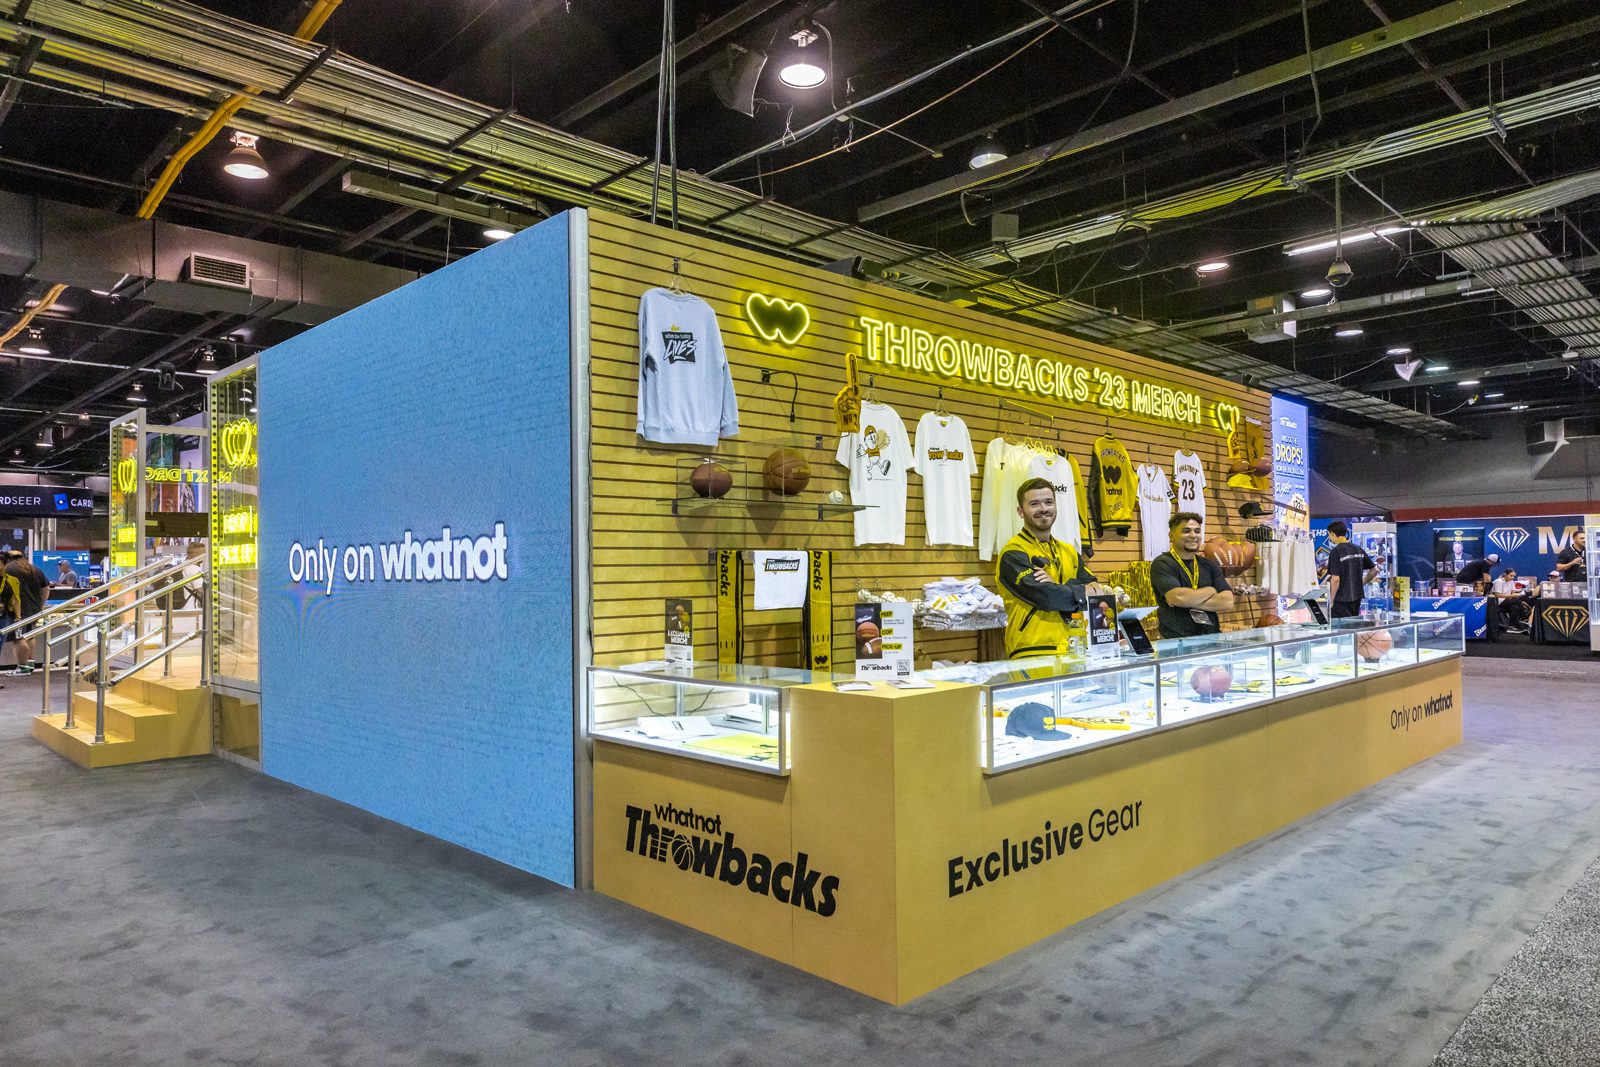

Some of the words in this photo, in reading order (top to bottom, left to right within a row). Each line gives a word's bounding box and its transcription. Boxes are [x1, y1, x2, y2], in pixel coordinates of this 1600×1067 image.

[663, 339, 697, 361] LIVES
[860, 316, 1089, 401] THROWBACKS
[1094, 367, 1125, 409] '23
[1131, 380, 1201, 423] MERCH
[1275, 442, 1304, 466] DROPS!
[1182, 479, 1195, 500] 23
[289, 538, 337, 595] Only
[343, 544, 375, 581] on
[380, 521, 507, 582] whatnot
[1391, 705, 1410, 731] Only
[1412, 705, 1422, 722] on
[1424, 690, 1453, 718] whatnot
[654, 803, 721, 836] whatnot
[625, 804, 840, 917] Throwbacks
[948, 820, 1083, 898] Exclusive
[1088, 800, 1142, 842] Gear
